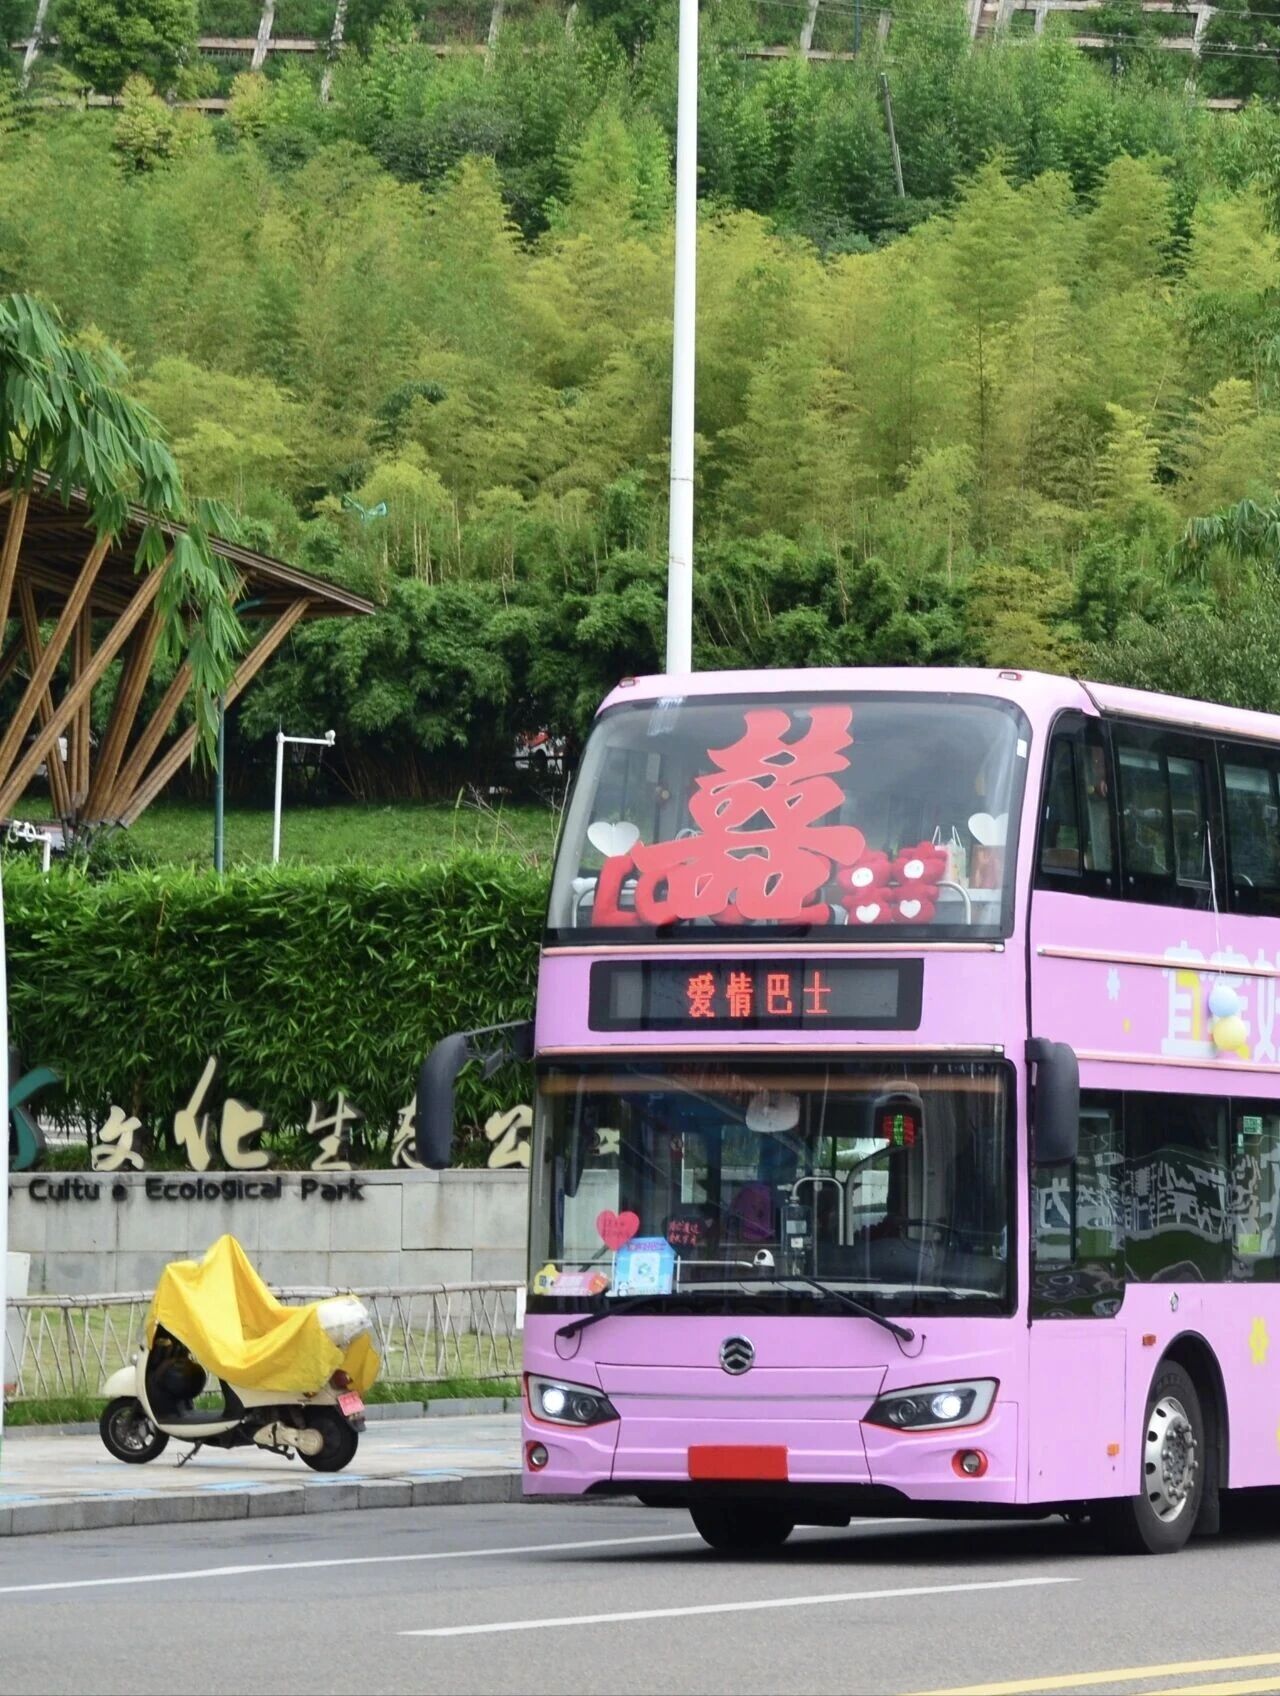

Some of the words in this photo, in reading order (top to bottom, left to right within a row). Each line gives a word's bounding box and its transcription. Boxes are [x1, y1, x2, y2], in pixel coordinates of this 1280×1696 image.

[686, 971, 832, 1018] 爱情巴士
[145, 1176, 283, 1202] Ecological
[300, 1177, 366, 1202] Park
